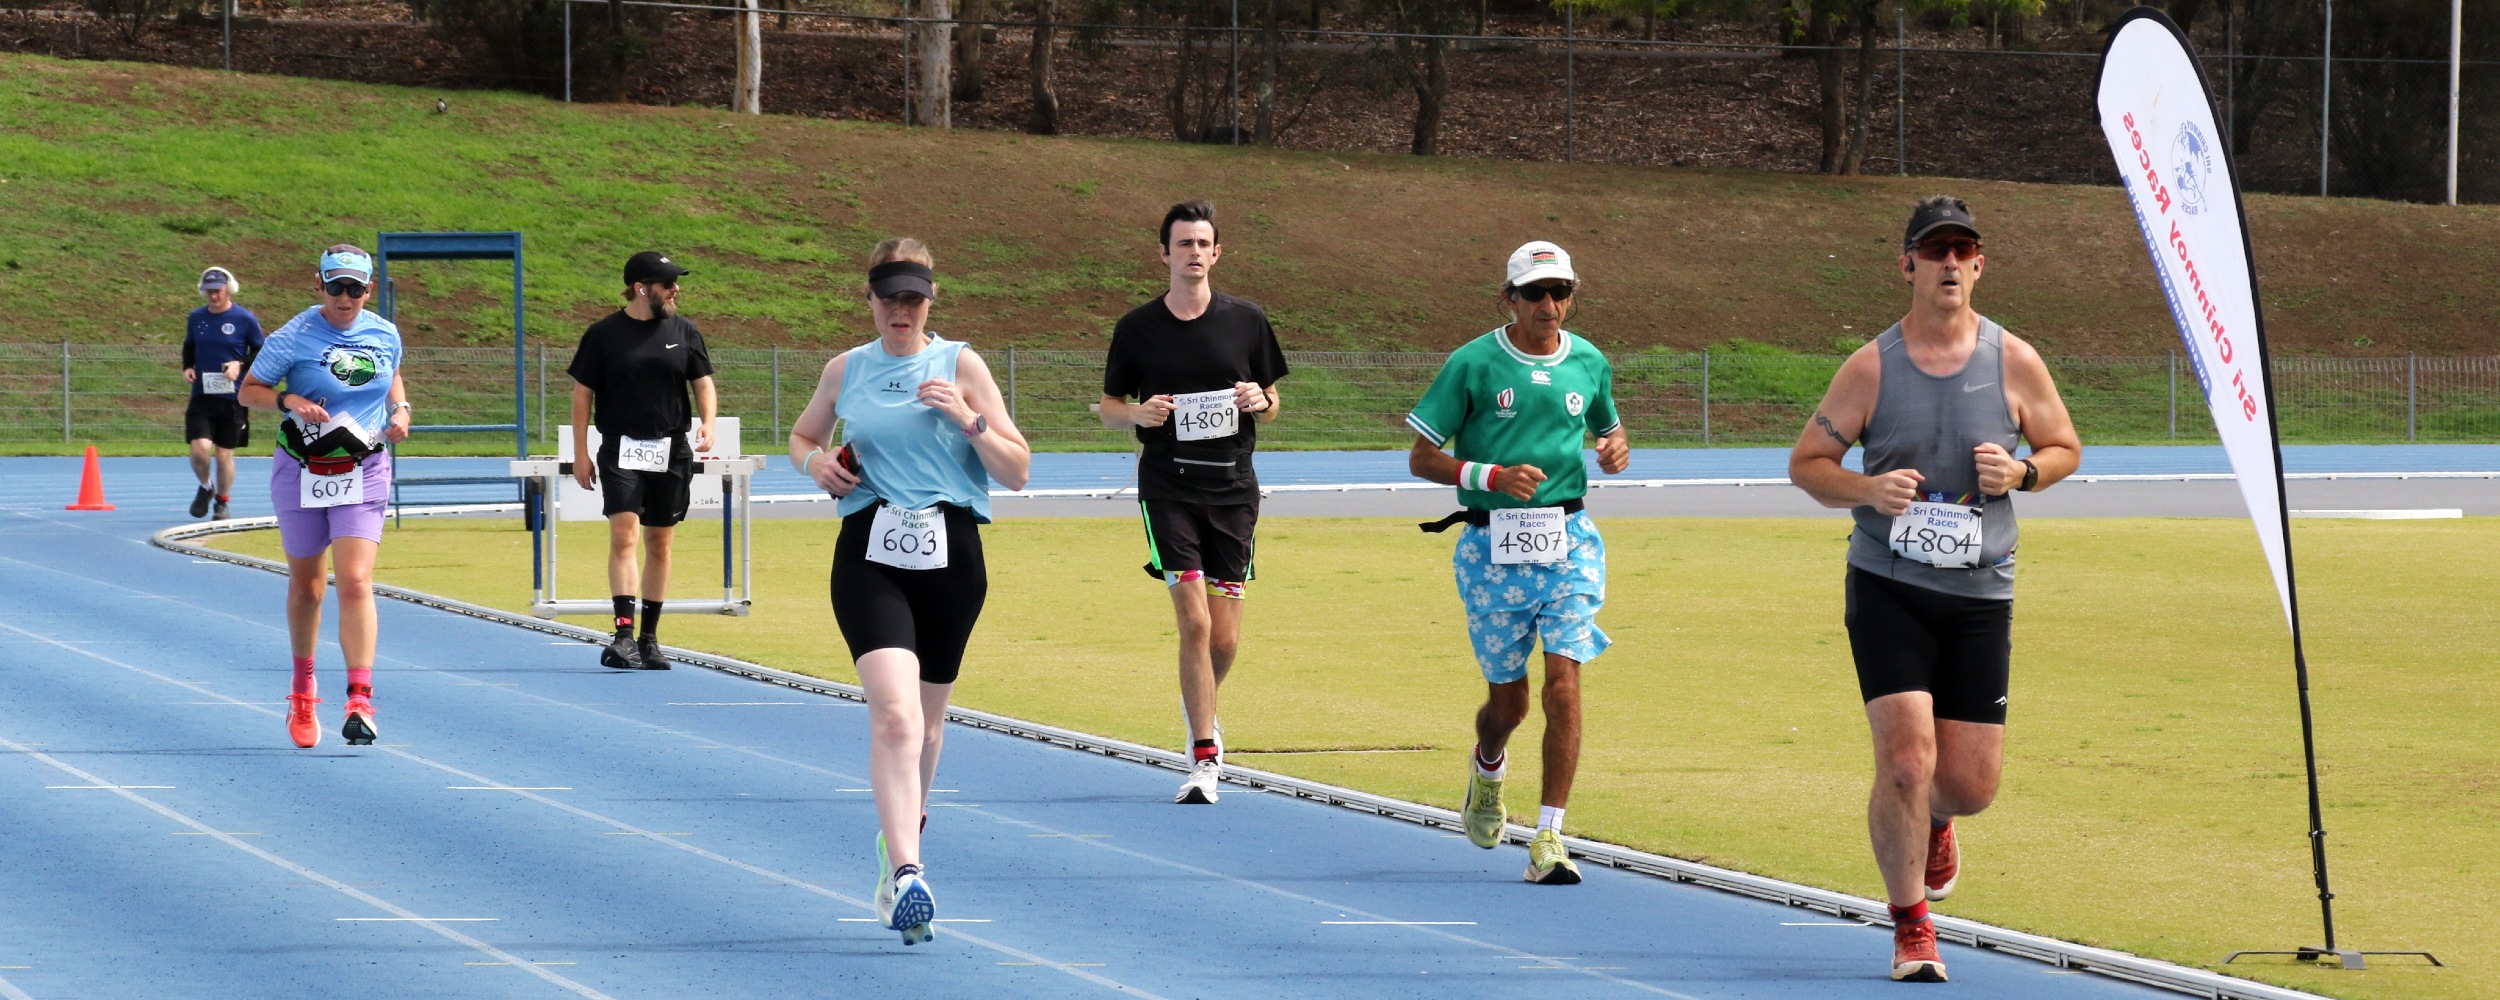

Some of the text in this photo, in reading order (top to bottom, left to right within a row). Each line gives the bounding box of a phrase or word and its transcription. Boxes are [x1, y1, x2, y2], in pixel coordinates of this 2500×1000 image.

[1187, 393, 1233, 405] Sri Chinmoy
[1180, 407, 1234, 432] 4809
[622, 447, 665, 465] 4805
[312, 478, 354, 498] 607
[890, 507, 938, 520] Sri Chinmoy
[1506, 511, 1559, 520] Sri Chinmoy
[1913, 506, 1974, 522] Sri Chinmoy
[901, 519, 929, 528] Races
[1927, 517, 1959, 528] Races
[883, 528, 937, 556] 603
[1498, 530, 1563, 554] 4807
[1895, 525, 1981, 555] 4804
